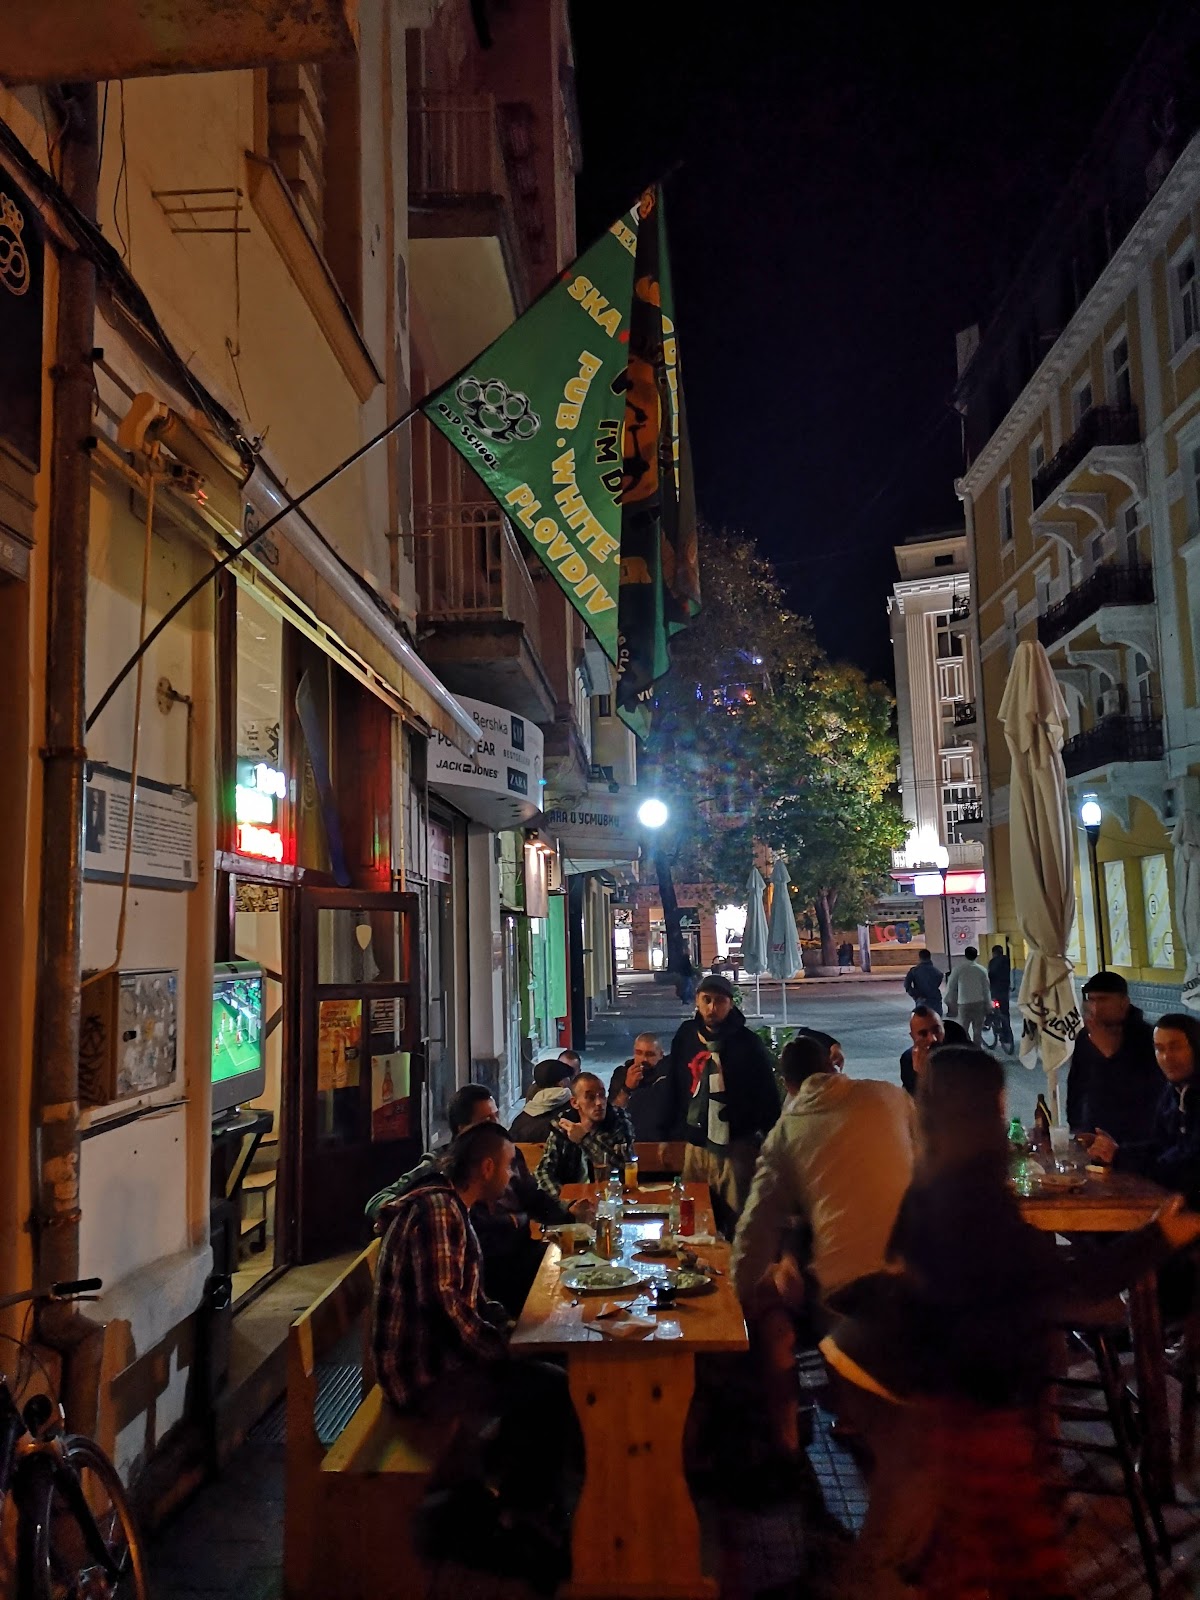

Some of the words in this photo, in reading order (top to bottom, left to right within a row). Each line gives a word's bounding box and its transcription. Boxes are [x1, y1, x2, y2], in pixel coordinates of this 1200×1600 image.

[567, 276, 622, 338] SKA
[555, 350, 603, 430] PUB
[438, 403, 462, 425] OLD
[461, 425, 500, 472] SCHOOL
[595, 419, 619, 464] I'M
[552, 447, 620, 563] WHITE
[505, 483, 616, 614] PLOVDIV
[473, 711, 508, 735] Bershka
[436, 759, 461, 772] JACK
[471, 765, 498, 779] JONES
[510, 773, 527, 790] ZARA
[578, 812, 620, 827] УСМИВКИ
[949, 896, 966, 905] Тук
[950, 906, 961, 914] за
[962, 904, 980, 912] вас.
